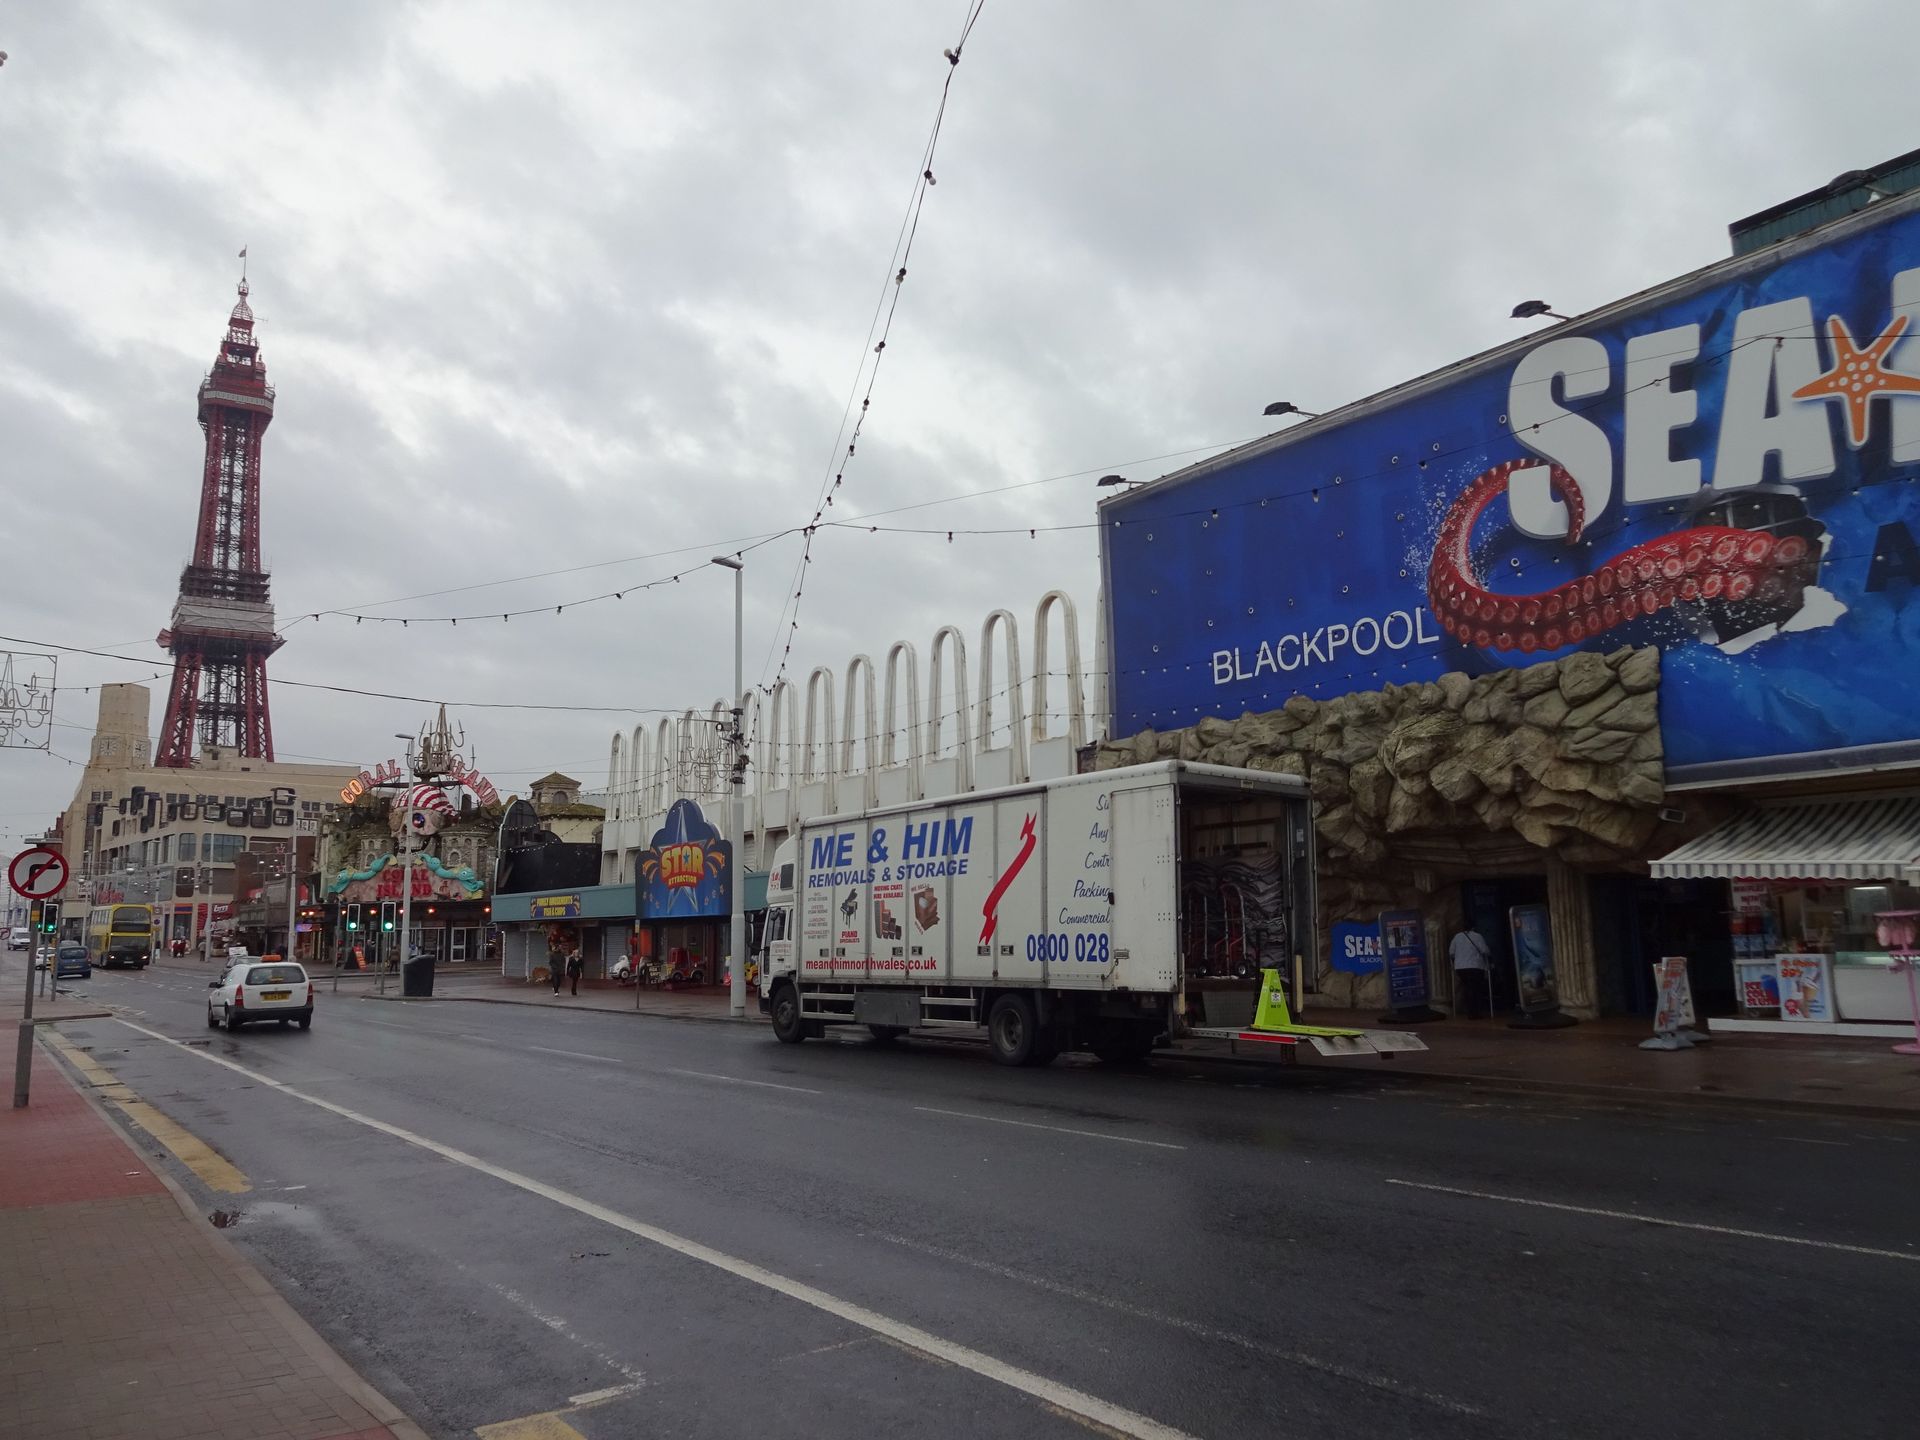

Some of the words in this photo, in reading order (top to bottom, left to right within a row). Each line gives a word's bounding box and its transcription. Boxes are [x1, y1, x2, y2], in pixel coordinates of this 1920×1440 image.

[1507, 296, 1836, 541] SEA
[1212, 607, 1440, 685] BLACKPOOL
[340, 758, 401, 804] CORAL
[810, 832, 855, 869] ME
[867, 828, 889, 864] &
[902, 816, 974, 860] HIM
[1090, 822, 1109, 844] Any
[661, 845, 704, 878] STAR
[808, 868, 876, 888] REMOVALS
[882, 867, 891, 882] &
[896, 859, 969, 881] STORAGE
[383, 869, 429, 882] COAL
[376, 884, 433, 898] ISLND
[1059, 907, 1110, 925] Commercial
[841, 930, 858, 939] PIANO
[1026, 933, 1069, 962] 0800
[1074, 933, 1110, 962] 028
[1344, 934, 1375, 958] SEA
[805, 957, 937, 970] meandhimnorthwales.co.uk
